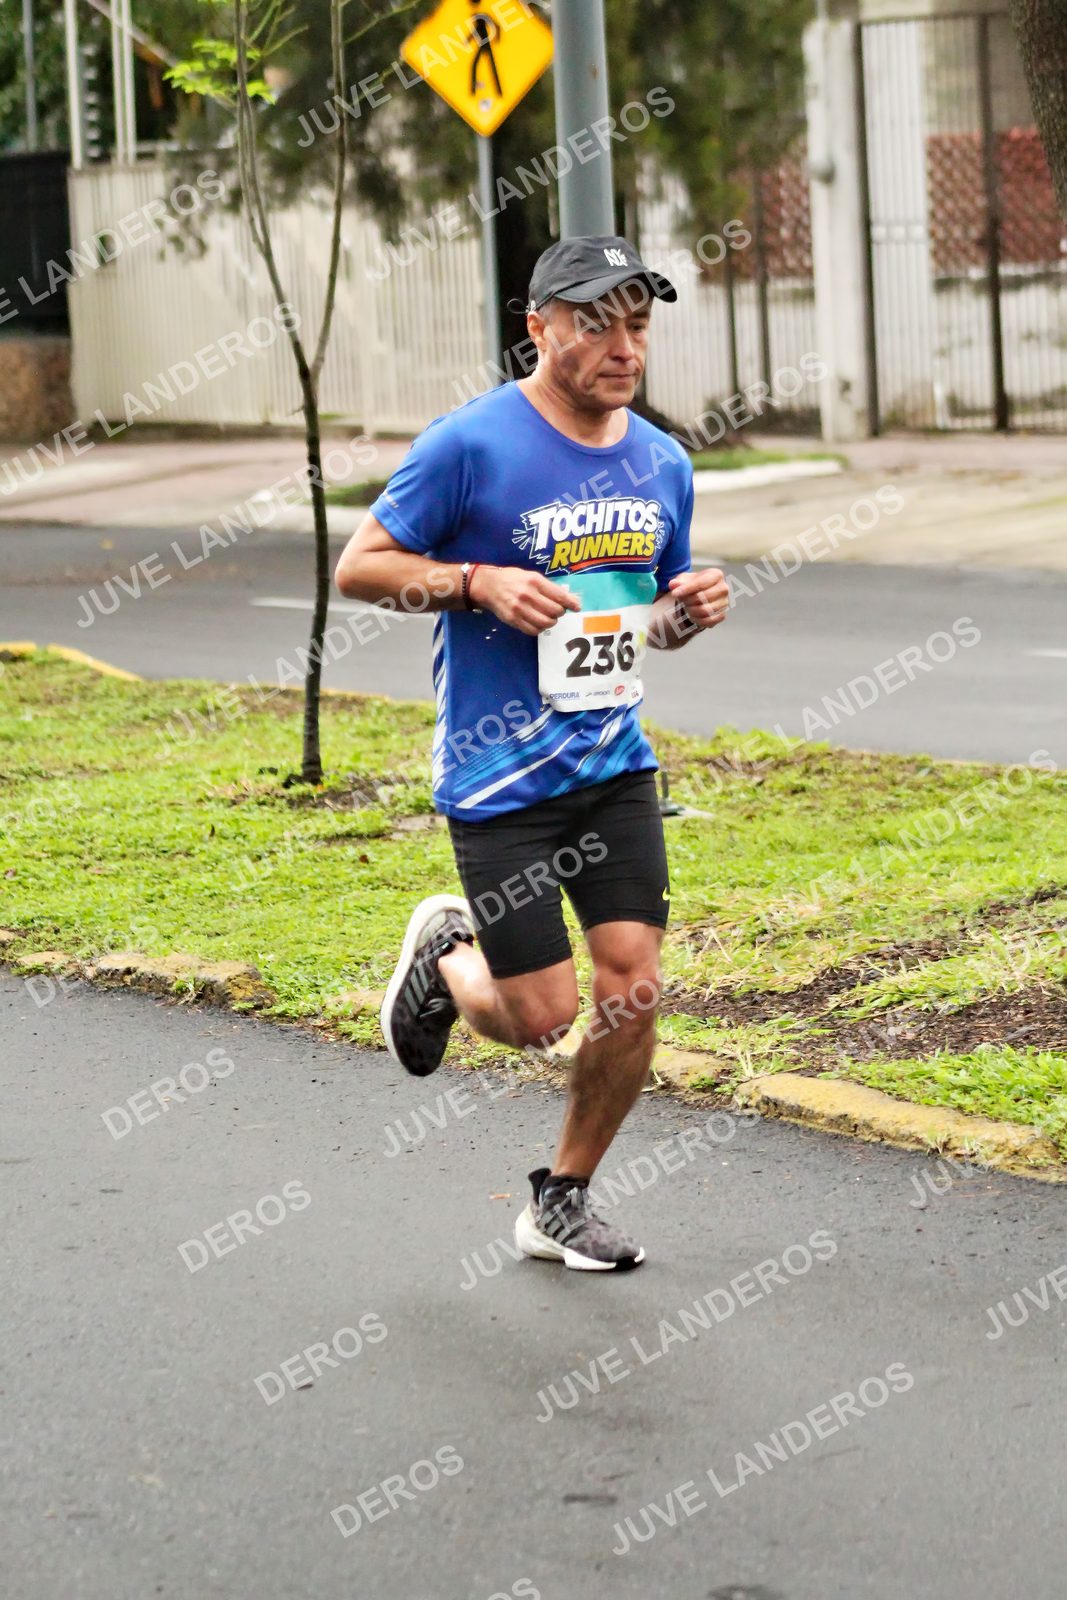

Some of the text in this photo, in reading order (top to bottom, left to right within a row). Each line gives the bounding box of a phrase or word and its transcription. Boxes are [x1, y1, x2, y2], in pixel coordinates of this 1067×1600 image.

[528, 500, 659, 551] TOCHITOS
[550, 531, 656, 569] RUNNERS
[565, 631, 635, 678] 236
